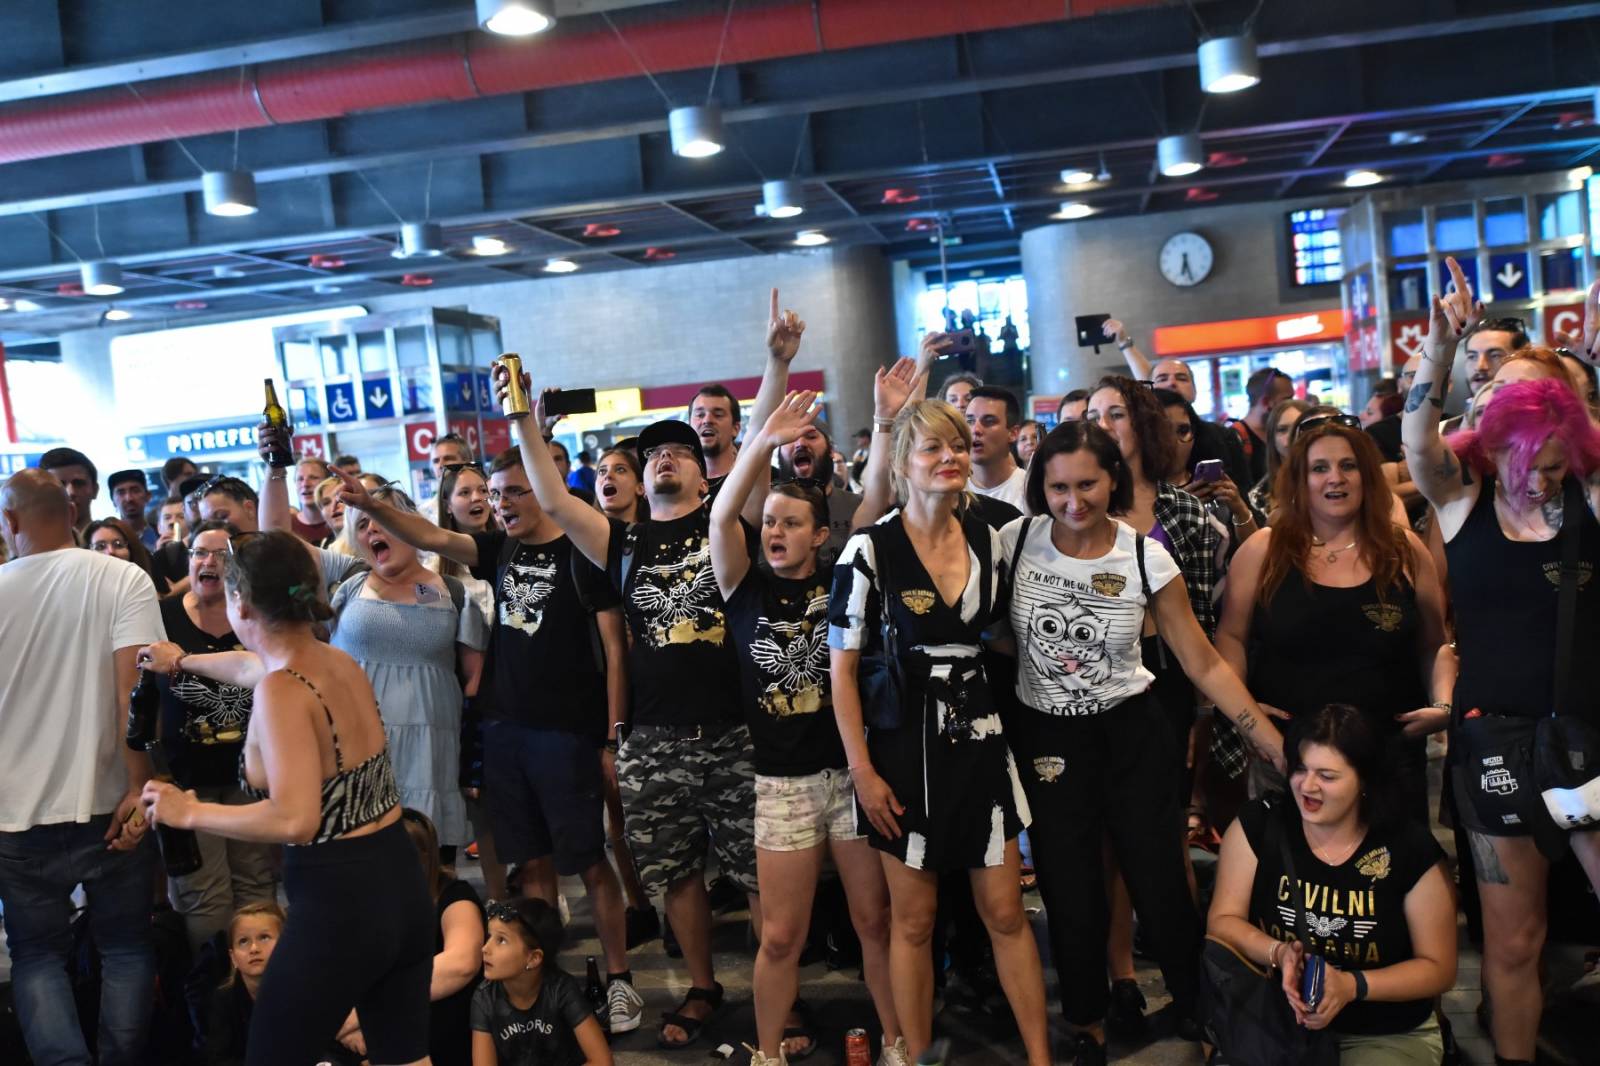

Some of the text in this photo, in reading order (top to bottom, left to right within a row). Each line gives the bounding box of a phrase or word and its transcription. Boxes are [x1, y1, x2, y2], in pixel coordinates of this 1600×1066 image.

[1552, 311, 1580, 341] C
[167, 427, 258, 453] POTREFE
[413, 428, 434, 455] C
[1027, 570, 1041, 582] I'M
[1043, 574, 1061, 587] NOT
[1062, 578, 1076, 590] ME
[1278, 874, 1376, 917] CVILNÍ
